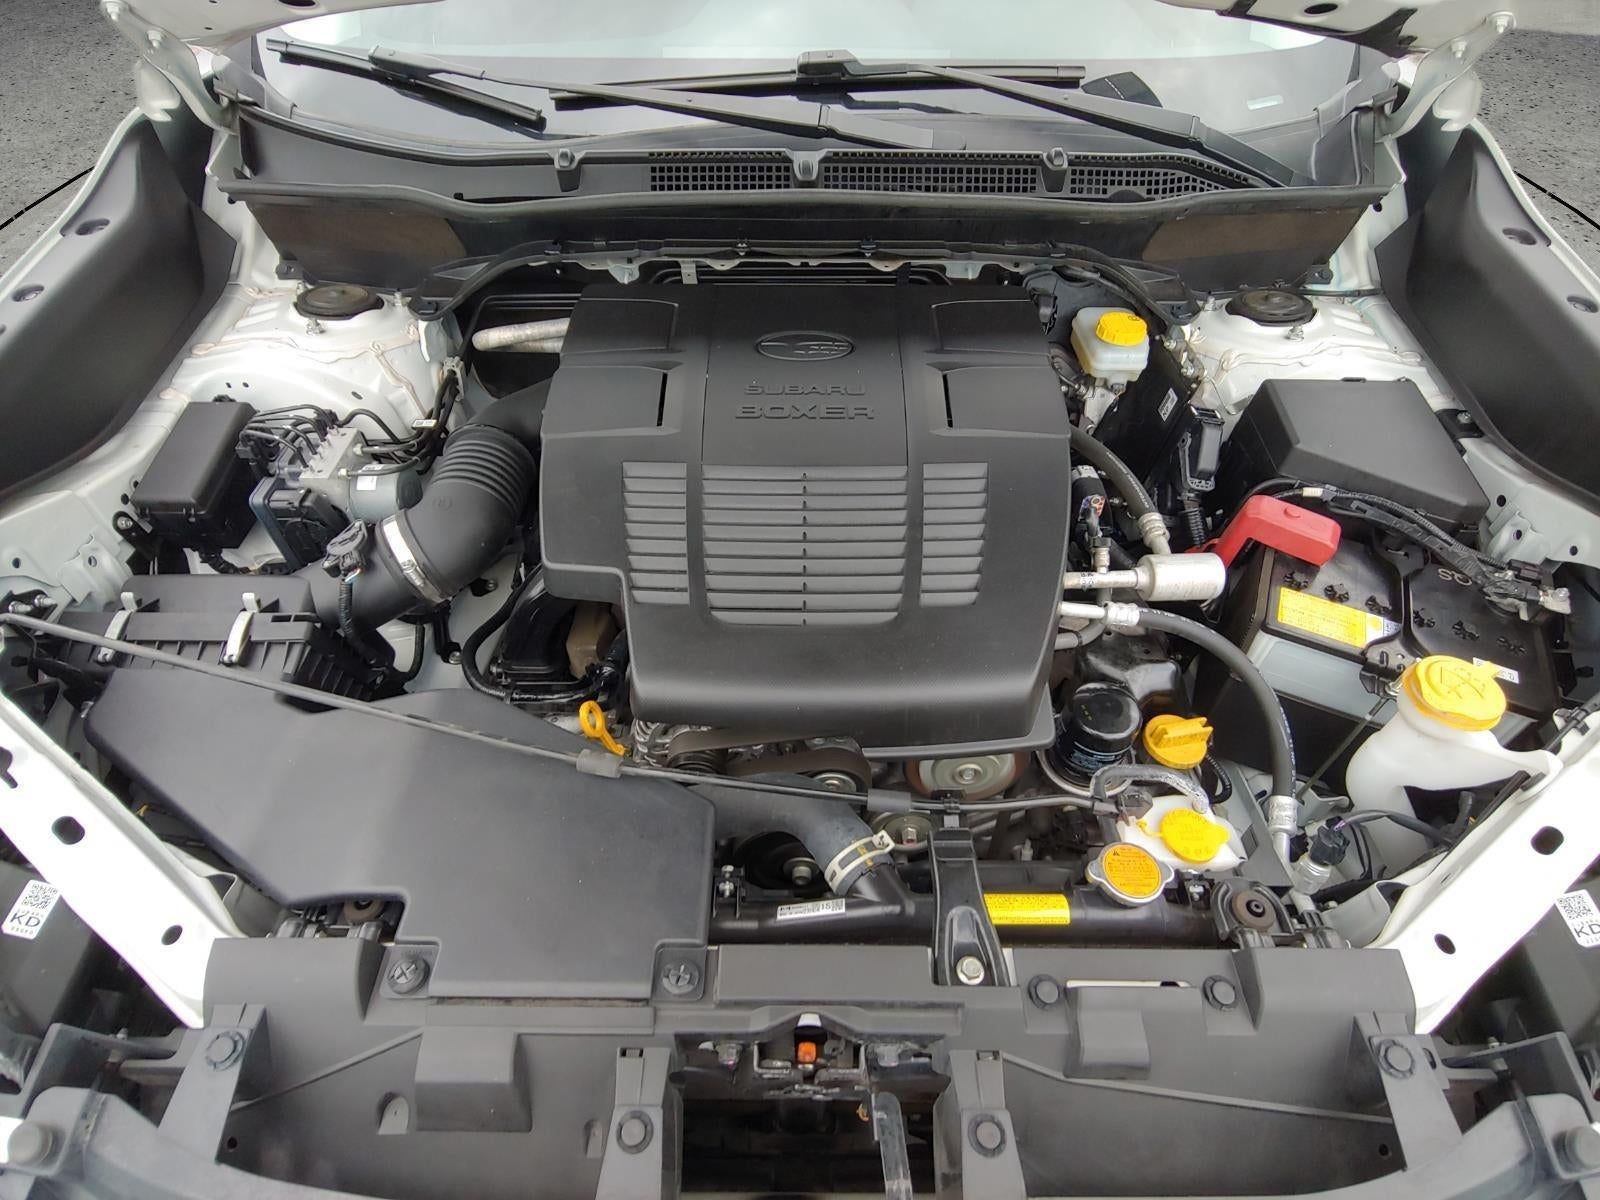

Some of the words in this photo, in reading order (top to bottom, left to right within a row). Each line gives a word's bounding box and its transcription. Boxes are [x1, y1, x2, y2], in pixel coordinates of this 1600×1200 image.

[743, 383, 867, 396] SUBARU
[735, 405, 876, 420] BOXER
[10, 912, 41, 928] KD
[1573, 923, 1600, 938] KD
